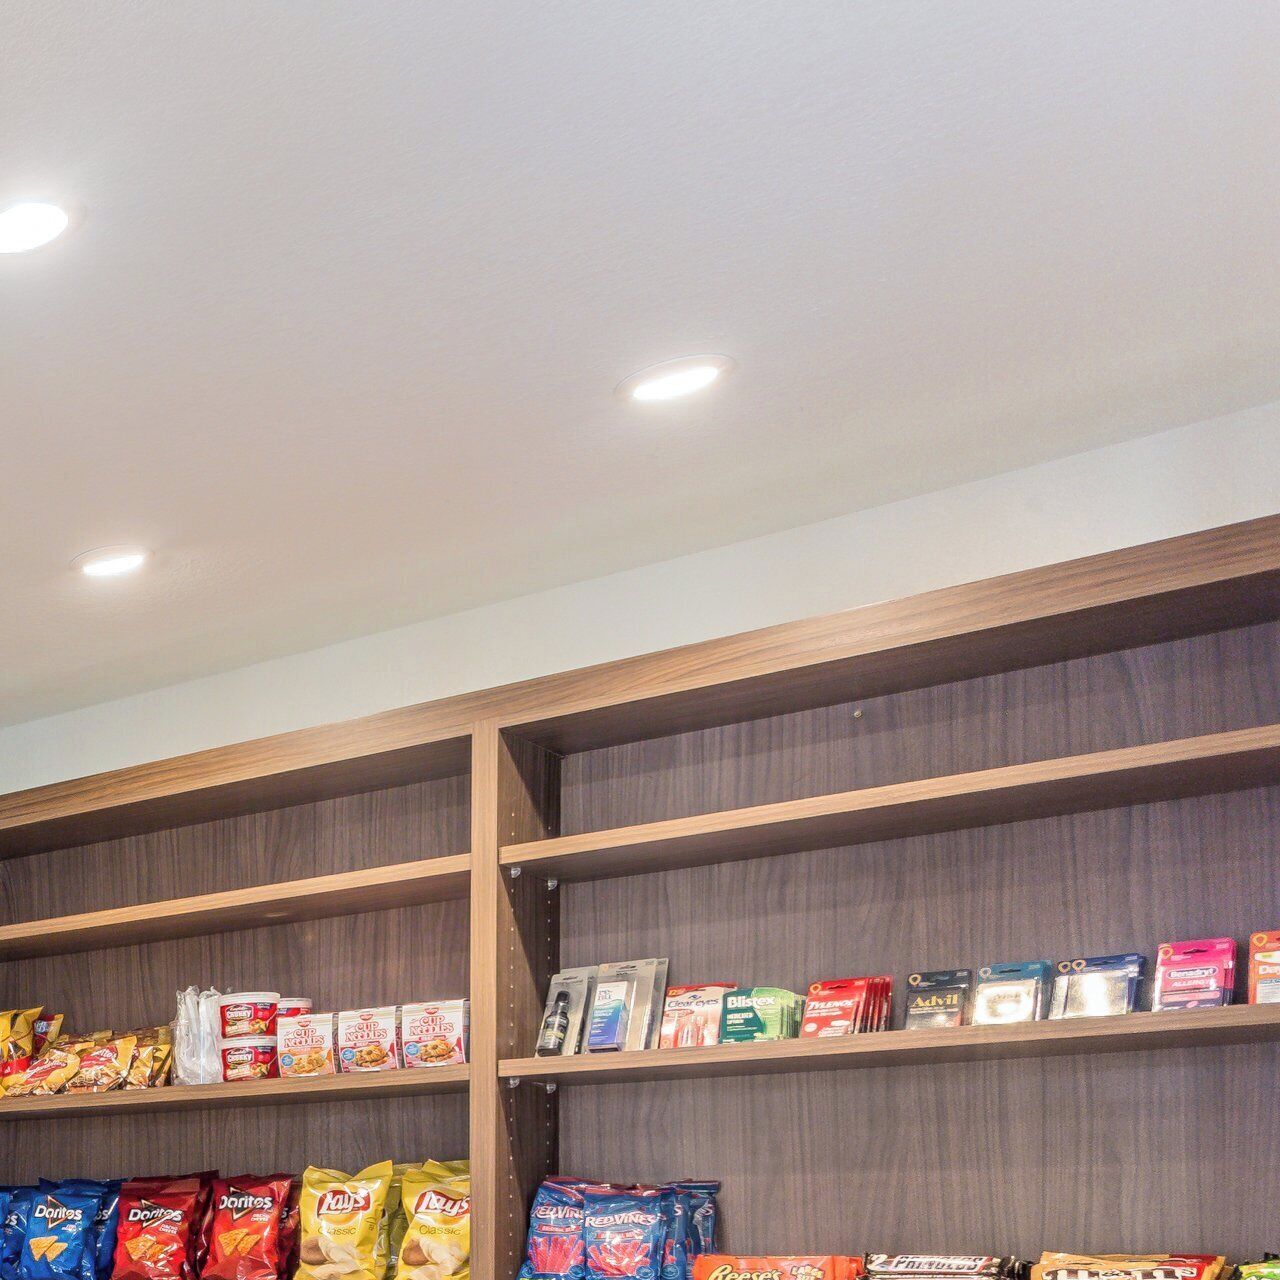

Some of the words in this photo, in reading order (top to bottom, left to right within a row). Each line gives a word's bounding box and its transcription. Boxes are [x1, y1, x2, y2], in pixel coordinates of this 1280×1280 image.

[1170, 968, 1214, 978] Benadryl
[1171, 979, 1211, 987] ALLERGY
[667, 1000, 692, 1009] Clear
[692, 998, 720, 1009] eyes
[726, 996, 776, 1009] Blistex
[808, 999, 855, 1009] TYLENOL
[912, 993, 958, 1008] Advil
[225, 1010, 252, 1020] CHUNKY
[420, 1015, 445, 1026] CUP
[355, 1021, 379, 1032] CUP
[409, 1022, 454, 1035] NOODLES
[292, 1028, 315, 1039] CUP
[345, 1029, 388, 1041] NOODLES
[284, 1037, 324, 1047] NOODLES
[227, 1053, 253, 1064] CHUNKY
[219, 1194, 273, 1211] Doritos
[318, 1190, 368, 1215] Lay's
[34, 1203, 83, 1220] Doritos
[128, 1207, 183, 1223] Doritos
[317, 1225, 357, 1236] Classic
[418, 1224, 463, 1236] Classic
